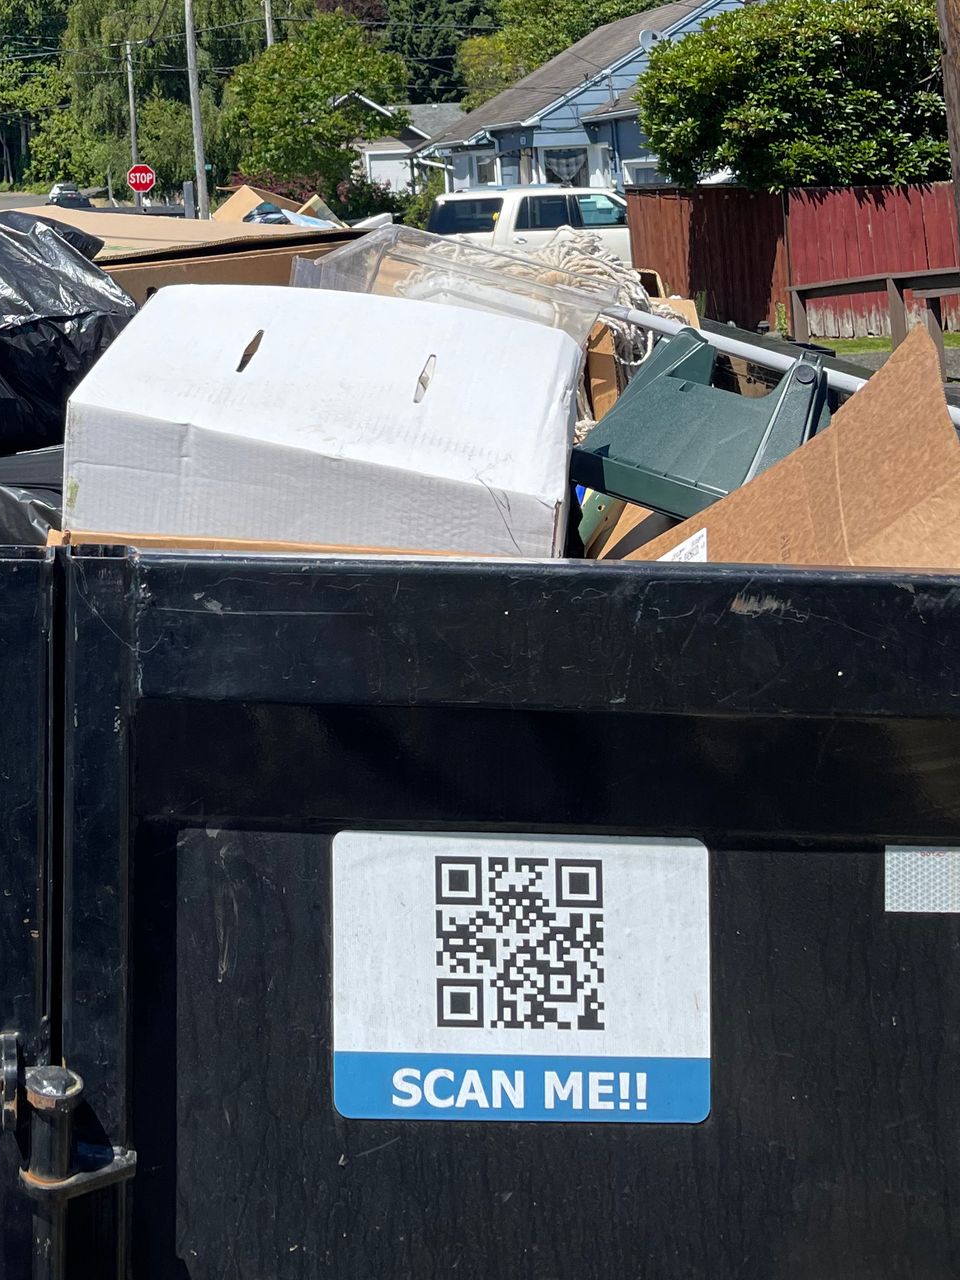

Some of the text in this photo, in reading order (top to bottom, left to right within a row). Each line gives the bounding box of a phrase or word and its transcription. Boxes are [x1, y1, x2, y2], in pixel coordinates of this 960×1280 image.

[129, 172, 153, 184] STOP
[391, 1067, 648, 1111] SCAN ME!!
